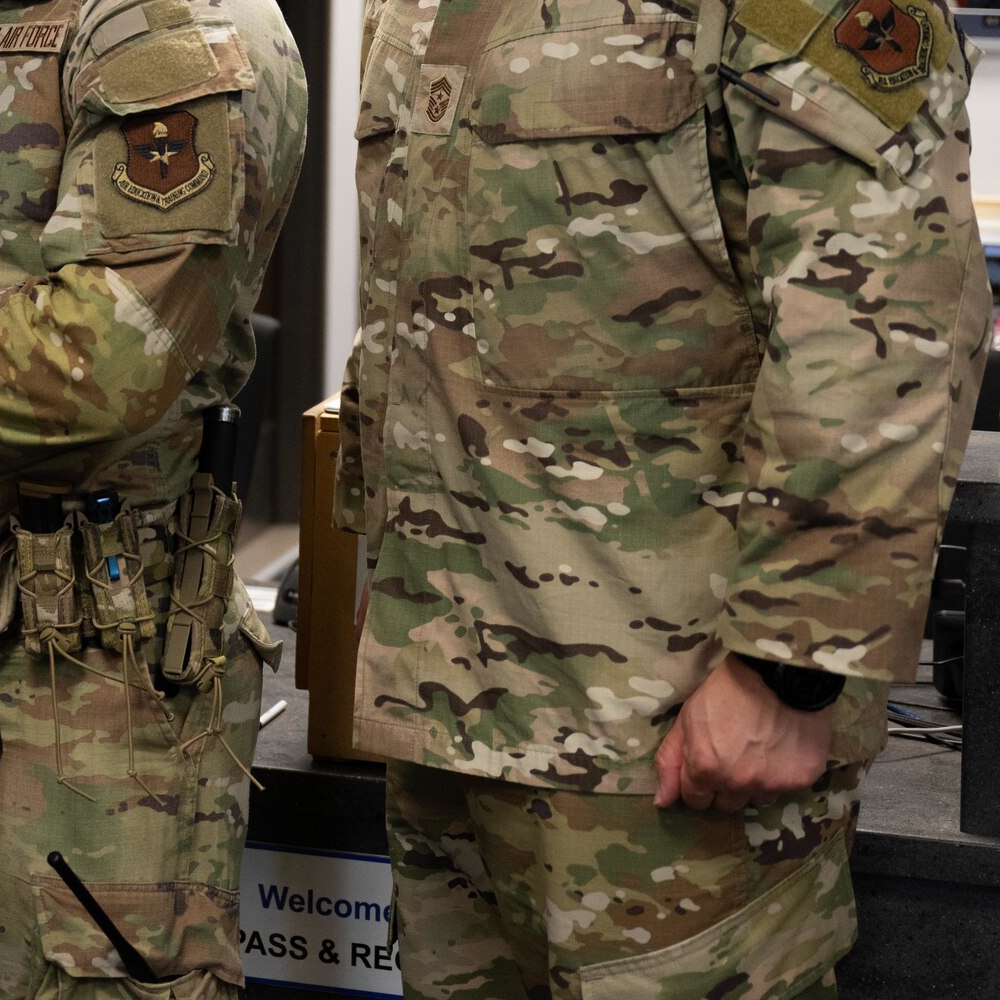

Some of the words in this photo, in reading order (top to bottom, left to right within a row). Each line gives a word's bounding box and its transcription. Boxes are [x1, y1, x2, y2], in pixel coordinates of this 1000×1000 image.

[19, 25, 64, 48] FORCE
[318, 938, 341, 965] &
[351, 942, 402, 972] RE
